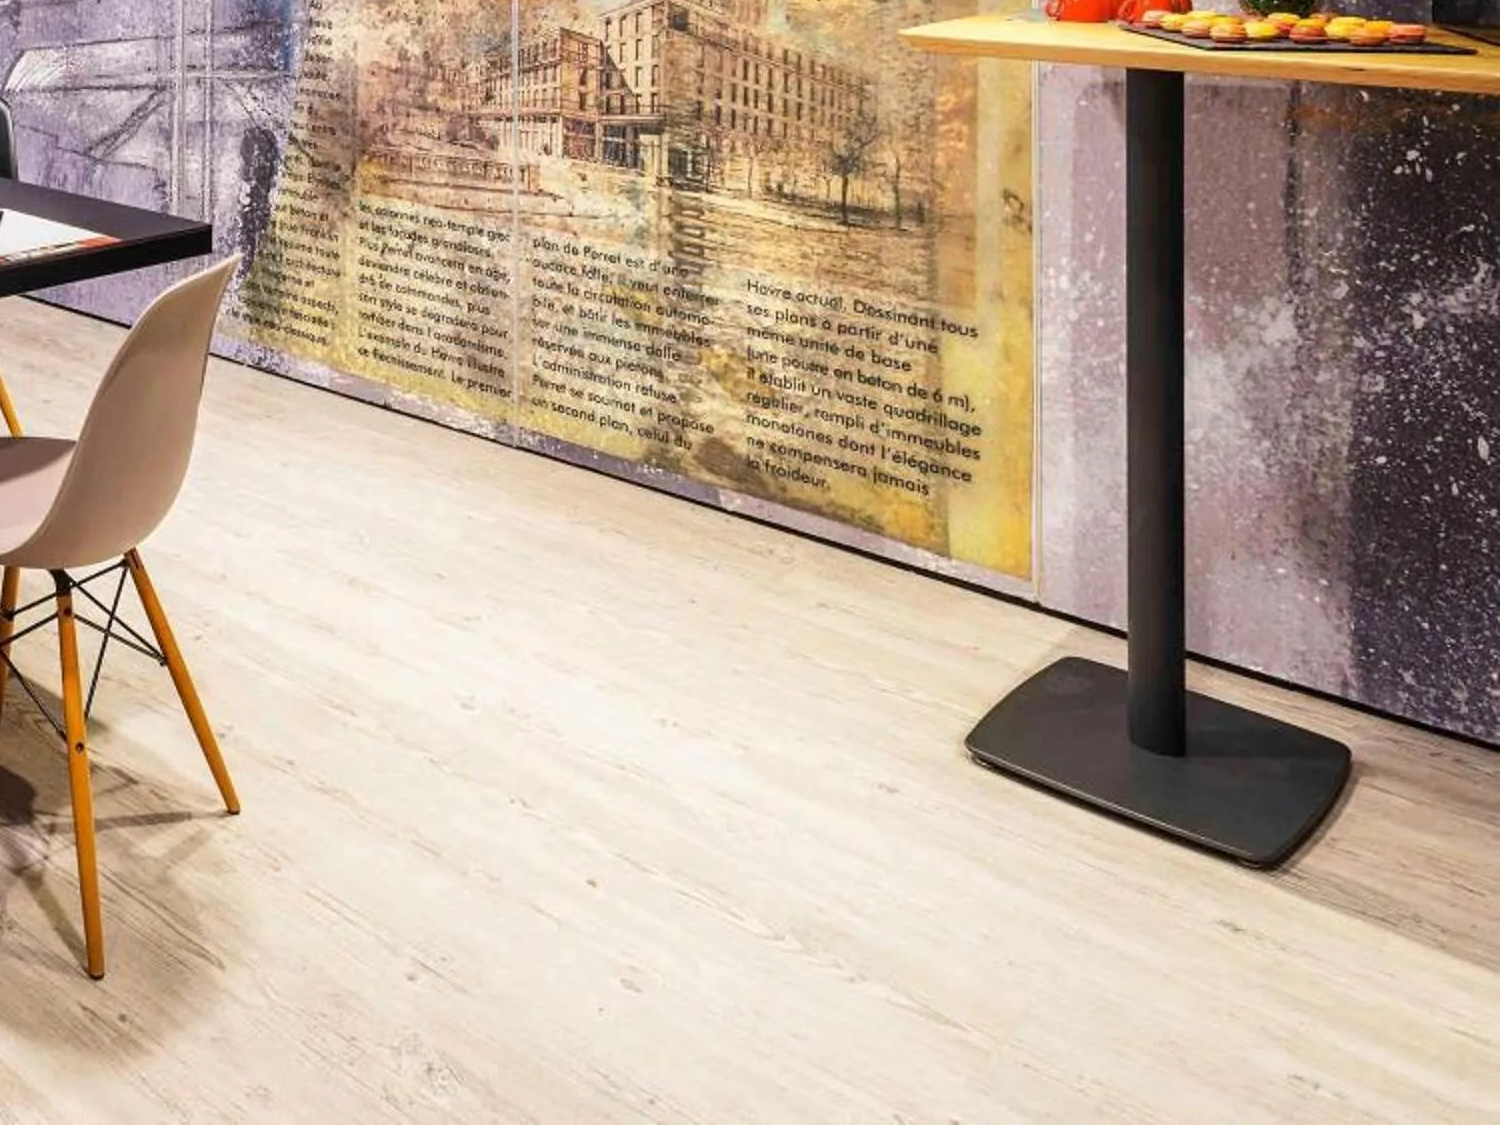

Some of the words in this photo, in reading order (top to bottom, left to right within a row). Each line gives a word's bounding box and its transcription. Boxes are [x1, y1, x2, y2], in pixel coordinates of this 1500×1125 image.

[747, 279, 791, 299] Havre
[853, 299, 935, 329] Dessinant
[941, 317, 979, 339] tous
[747, 304, 769, 317] ses
[775, 308, 816, 328] plans
[823, 317, 832, 330] à
[837, 320, 882, 341] partir
[888, 332, 938, 354] d'une
[845, 343, 864, 360] de
[872, 349, 912, 372] base
[834, 367, 853, 381] en
[858, 370, 902, 393] béton
[907, 382, 927, 399] de
[934, 388, 943, 402] 6
[812, 385, 831, 399] un
[836, 391, 878, 410] vaste
[884, 402, 981, 437] quadrillage
[815, 406, 864, 430] rempli
[870, 419, 980, 461] d'immeubles
[746, 414, 832, 445] monotones
[838, 435, 875, 456] dont
[881, 445, 972, 483] l'élégance
[747, 455, 760, 470] la
[747, 437, 764, 449] ne
[770, 443, 867, 477] compensera
[873, 465, 929, 496] jamais
